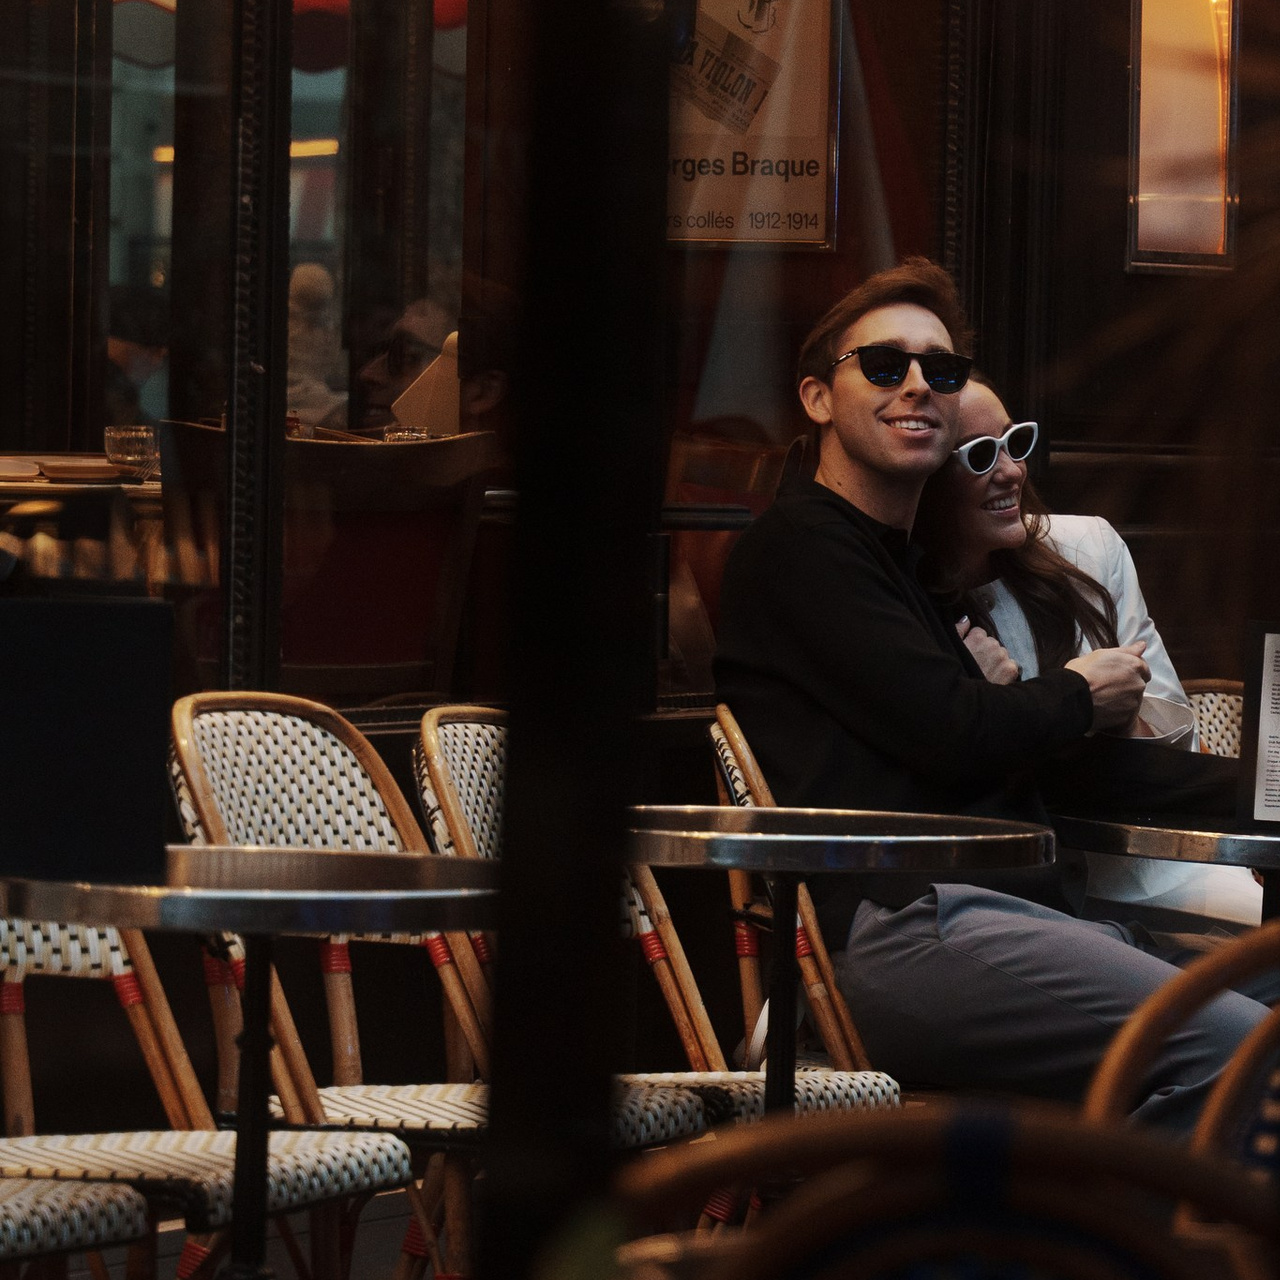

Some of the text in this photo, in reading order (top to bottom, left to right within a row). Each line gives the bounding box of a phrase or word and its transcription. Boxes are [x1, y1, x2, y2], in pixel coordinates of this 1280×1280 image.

[672, 151, 820, 183] rges Braque
[686, 211, 735, 229] collés
[749, 212, 819, 230] 1912-1914
